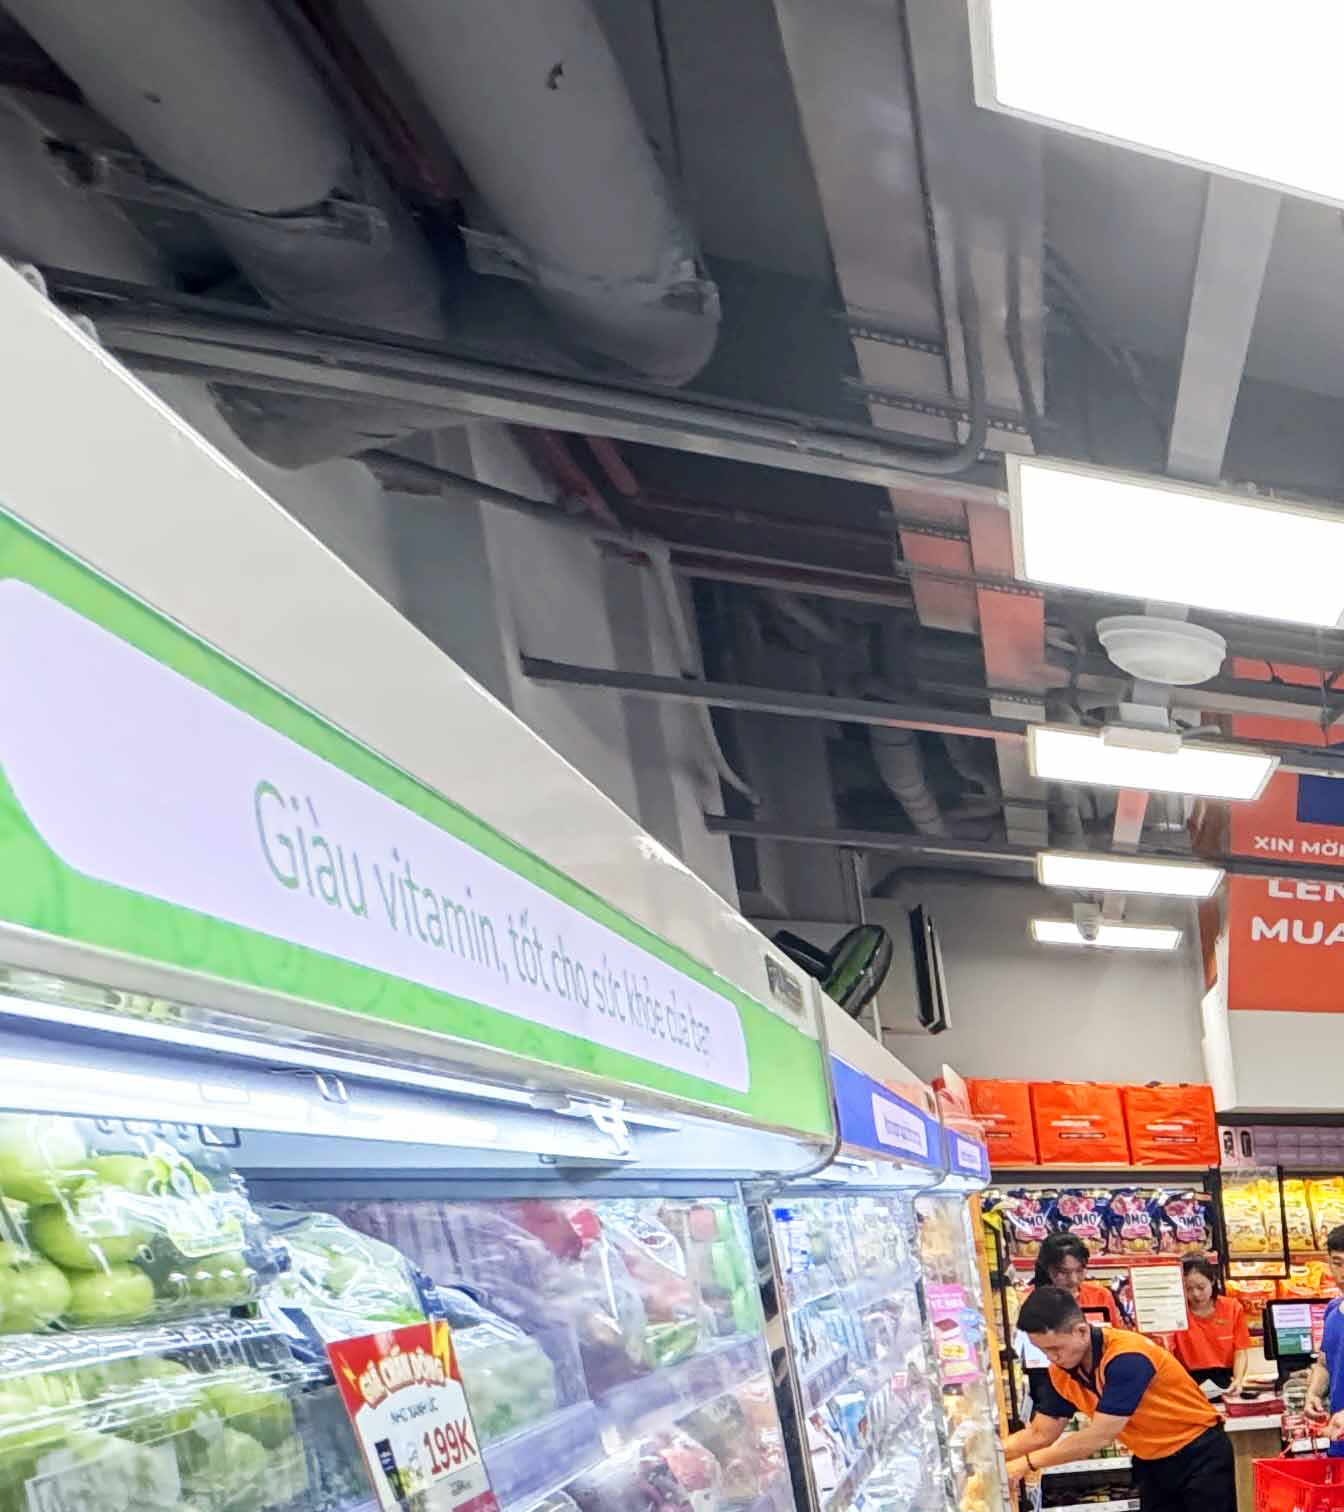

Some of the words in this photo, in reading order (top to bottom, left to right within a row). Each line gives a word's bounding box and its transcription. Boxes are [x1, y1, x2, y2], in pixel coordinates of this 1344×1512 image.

[1253, 835, 1294, 853] XIN
[253, 779, 369, 920] Giàu
[373, 846, 510, 985] vitamin,
[507, 907, 551, 993] tốt
[550, 933, 591, 1010] cho
[423, 1416, 477, 1476] 199K
